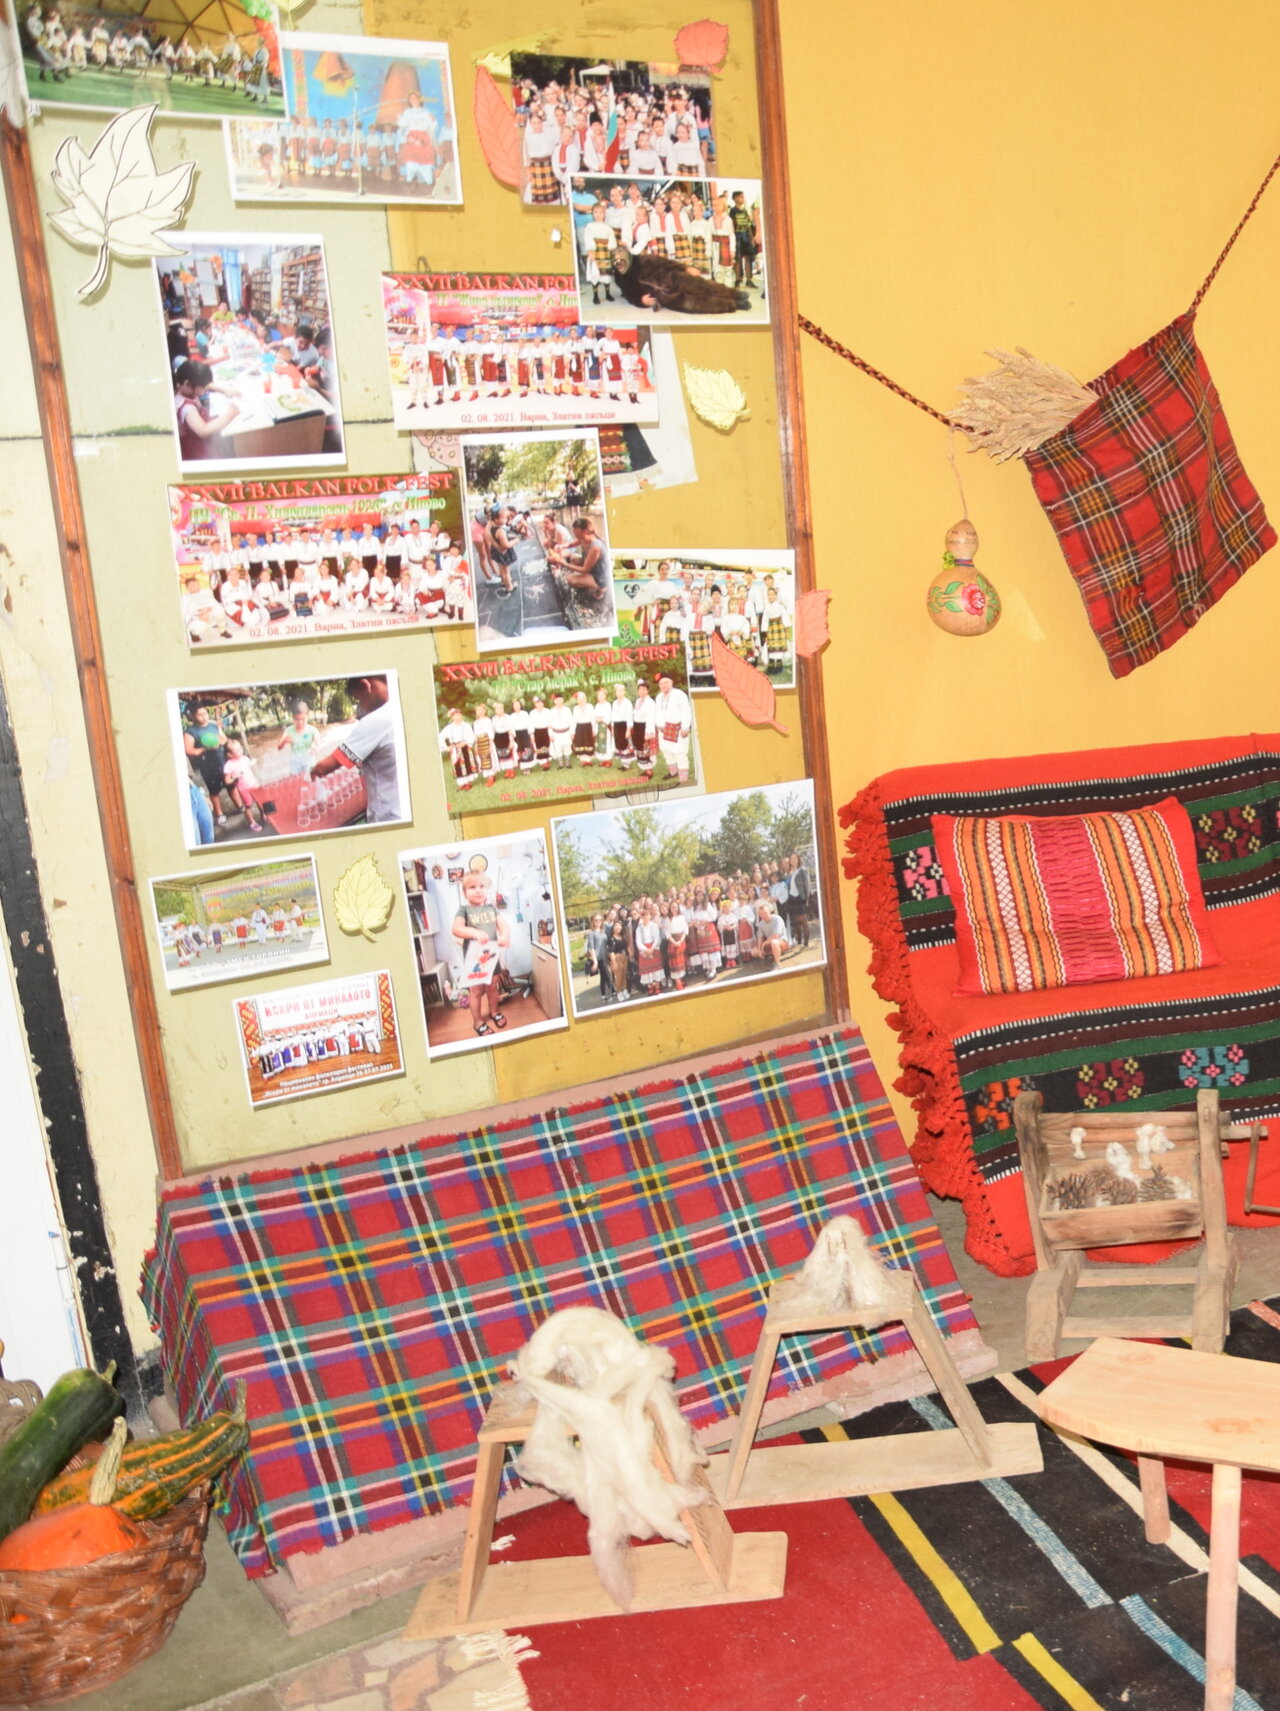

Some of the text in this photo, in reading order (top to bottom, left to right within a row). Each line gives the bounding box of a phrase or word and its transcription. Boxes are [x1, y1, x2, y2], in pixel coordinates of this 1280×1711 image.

[394, 274, 452, 290] XXVII
[457, 274, 538, 290] BALKAN
[461, 412, 616, 423] 02. 08. 2021. Варна, Златни пясъци
[180, 473, 453, 502] XXVII BALKAN FOLK FEST
[249, 616, 420, 638] 02. 08. 2021. Варна, Златни пясъци
[440, 644, 680, 681] XXVII BALKAN FOLK FEST
[264, 1001, 300, 1017] ИСКРИ
[303, 999, 315, 1010] ОТ
[319, 989, 371, 1007] МИНАЛОТО
[304, 1008, 339, 1020] АПРИЛЦИ
[280, 1062, 374, 1087] Национален фолклорен фестивал
